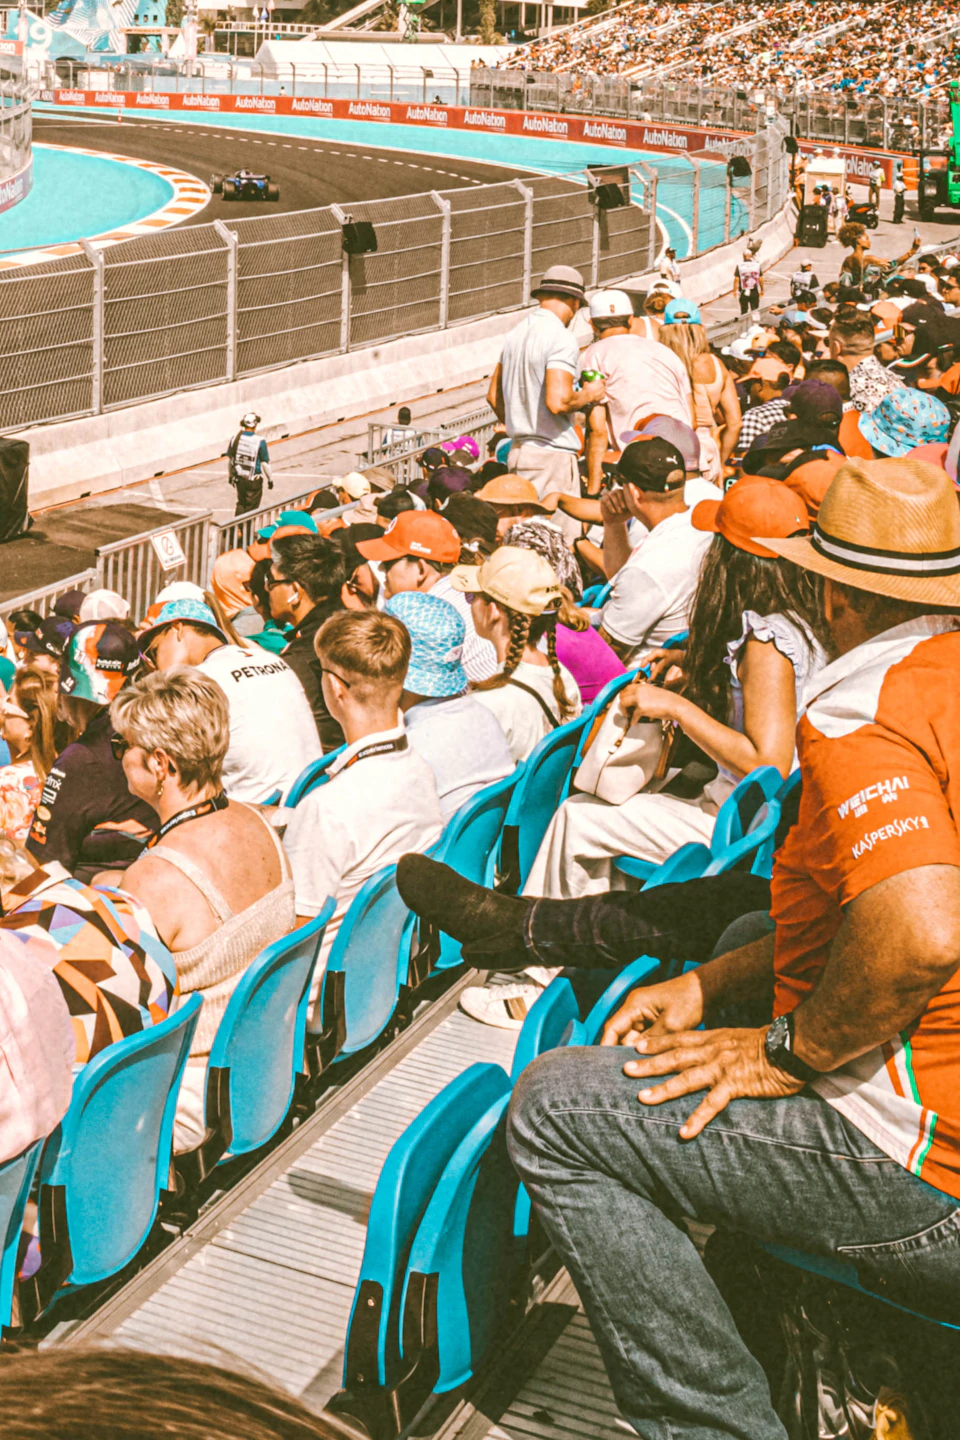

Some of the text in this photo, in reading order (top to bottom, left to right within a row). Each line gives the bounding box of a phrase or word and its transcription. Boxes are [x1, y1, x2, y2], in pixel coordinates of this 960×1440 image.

[136, 93, 170, 106] AutoNation
[182, 94, 220, 108] AutoNation
[235, 96, 276, 109] AutoNation
[291, 98, 333, 113] AutoNation
[348, 102, 391, 117] AutoNation
[406, 106, 448, 122] AutoNation
[464, 110, 506, 128] AutoNation
[523, 116, 568, 134] AutoNation
[583, 121, 627, 141] AutoNation
[643, 128, 688, 149] AutoNation
[231, 661, 289, 682] PETRONA
[837, 775, 910, 820] WEICHAI
[851, 816, 920, 860] KASPERSKY
